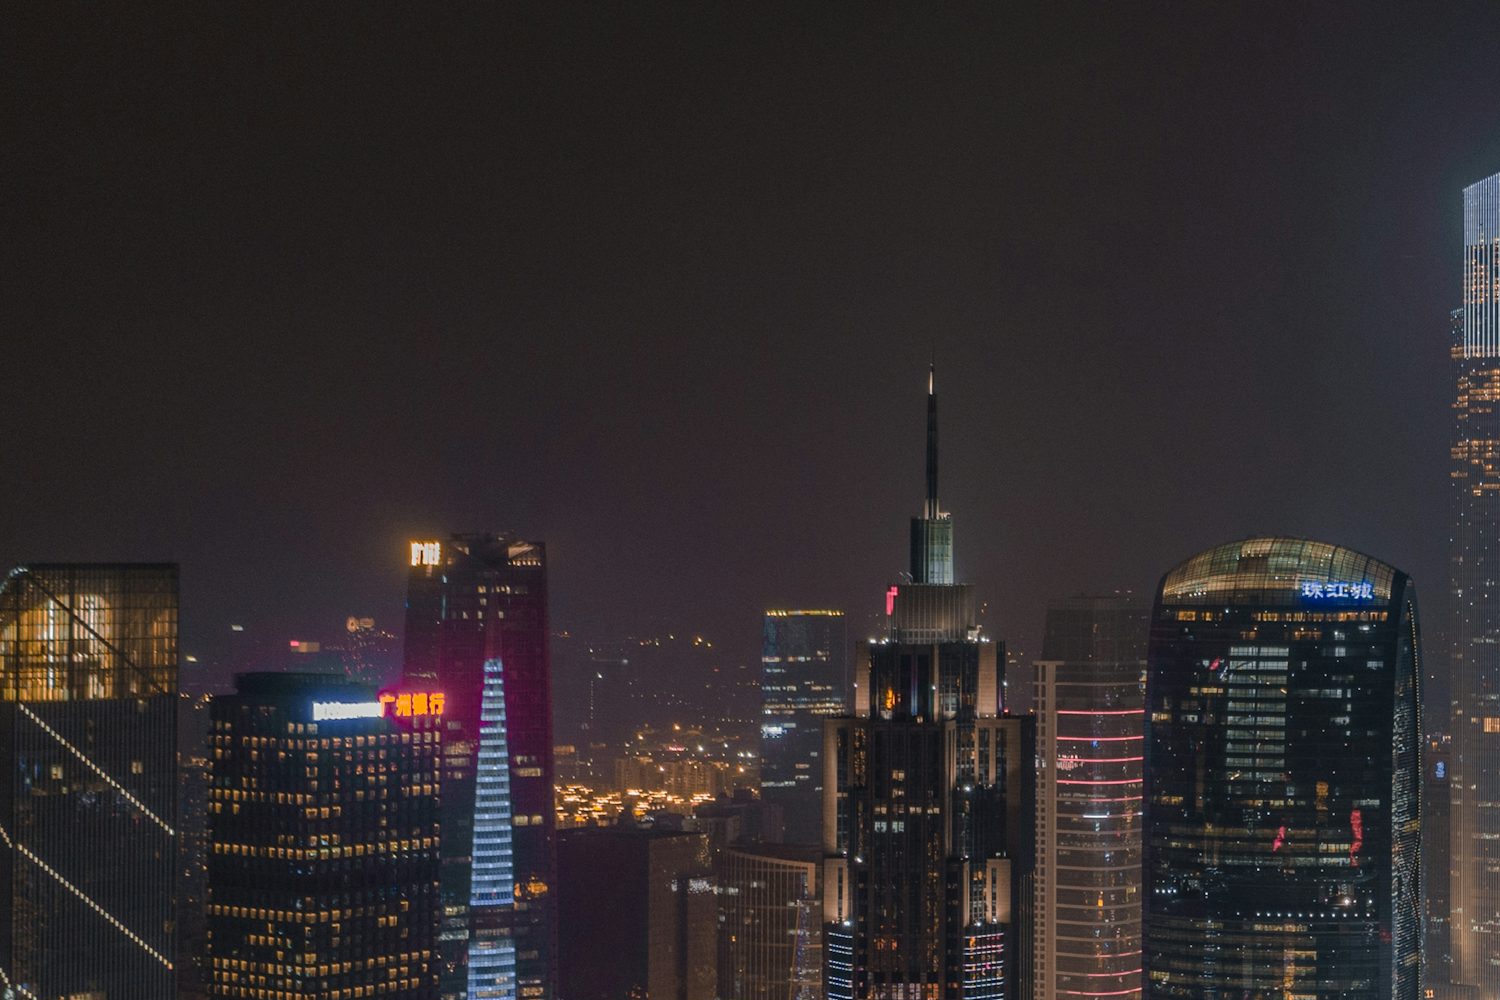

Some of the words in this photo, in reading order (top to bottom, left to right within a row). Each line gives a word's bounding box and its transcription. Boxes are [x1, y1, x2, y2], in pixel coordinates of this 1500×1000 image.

[1302, 581, 1373, 599] 珠江城
[380, 692, 445, 717] 广州银行
